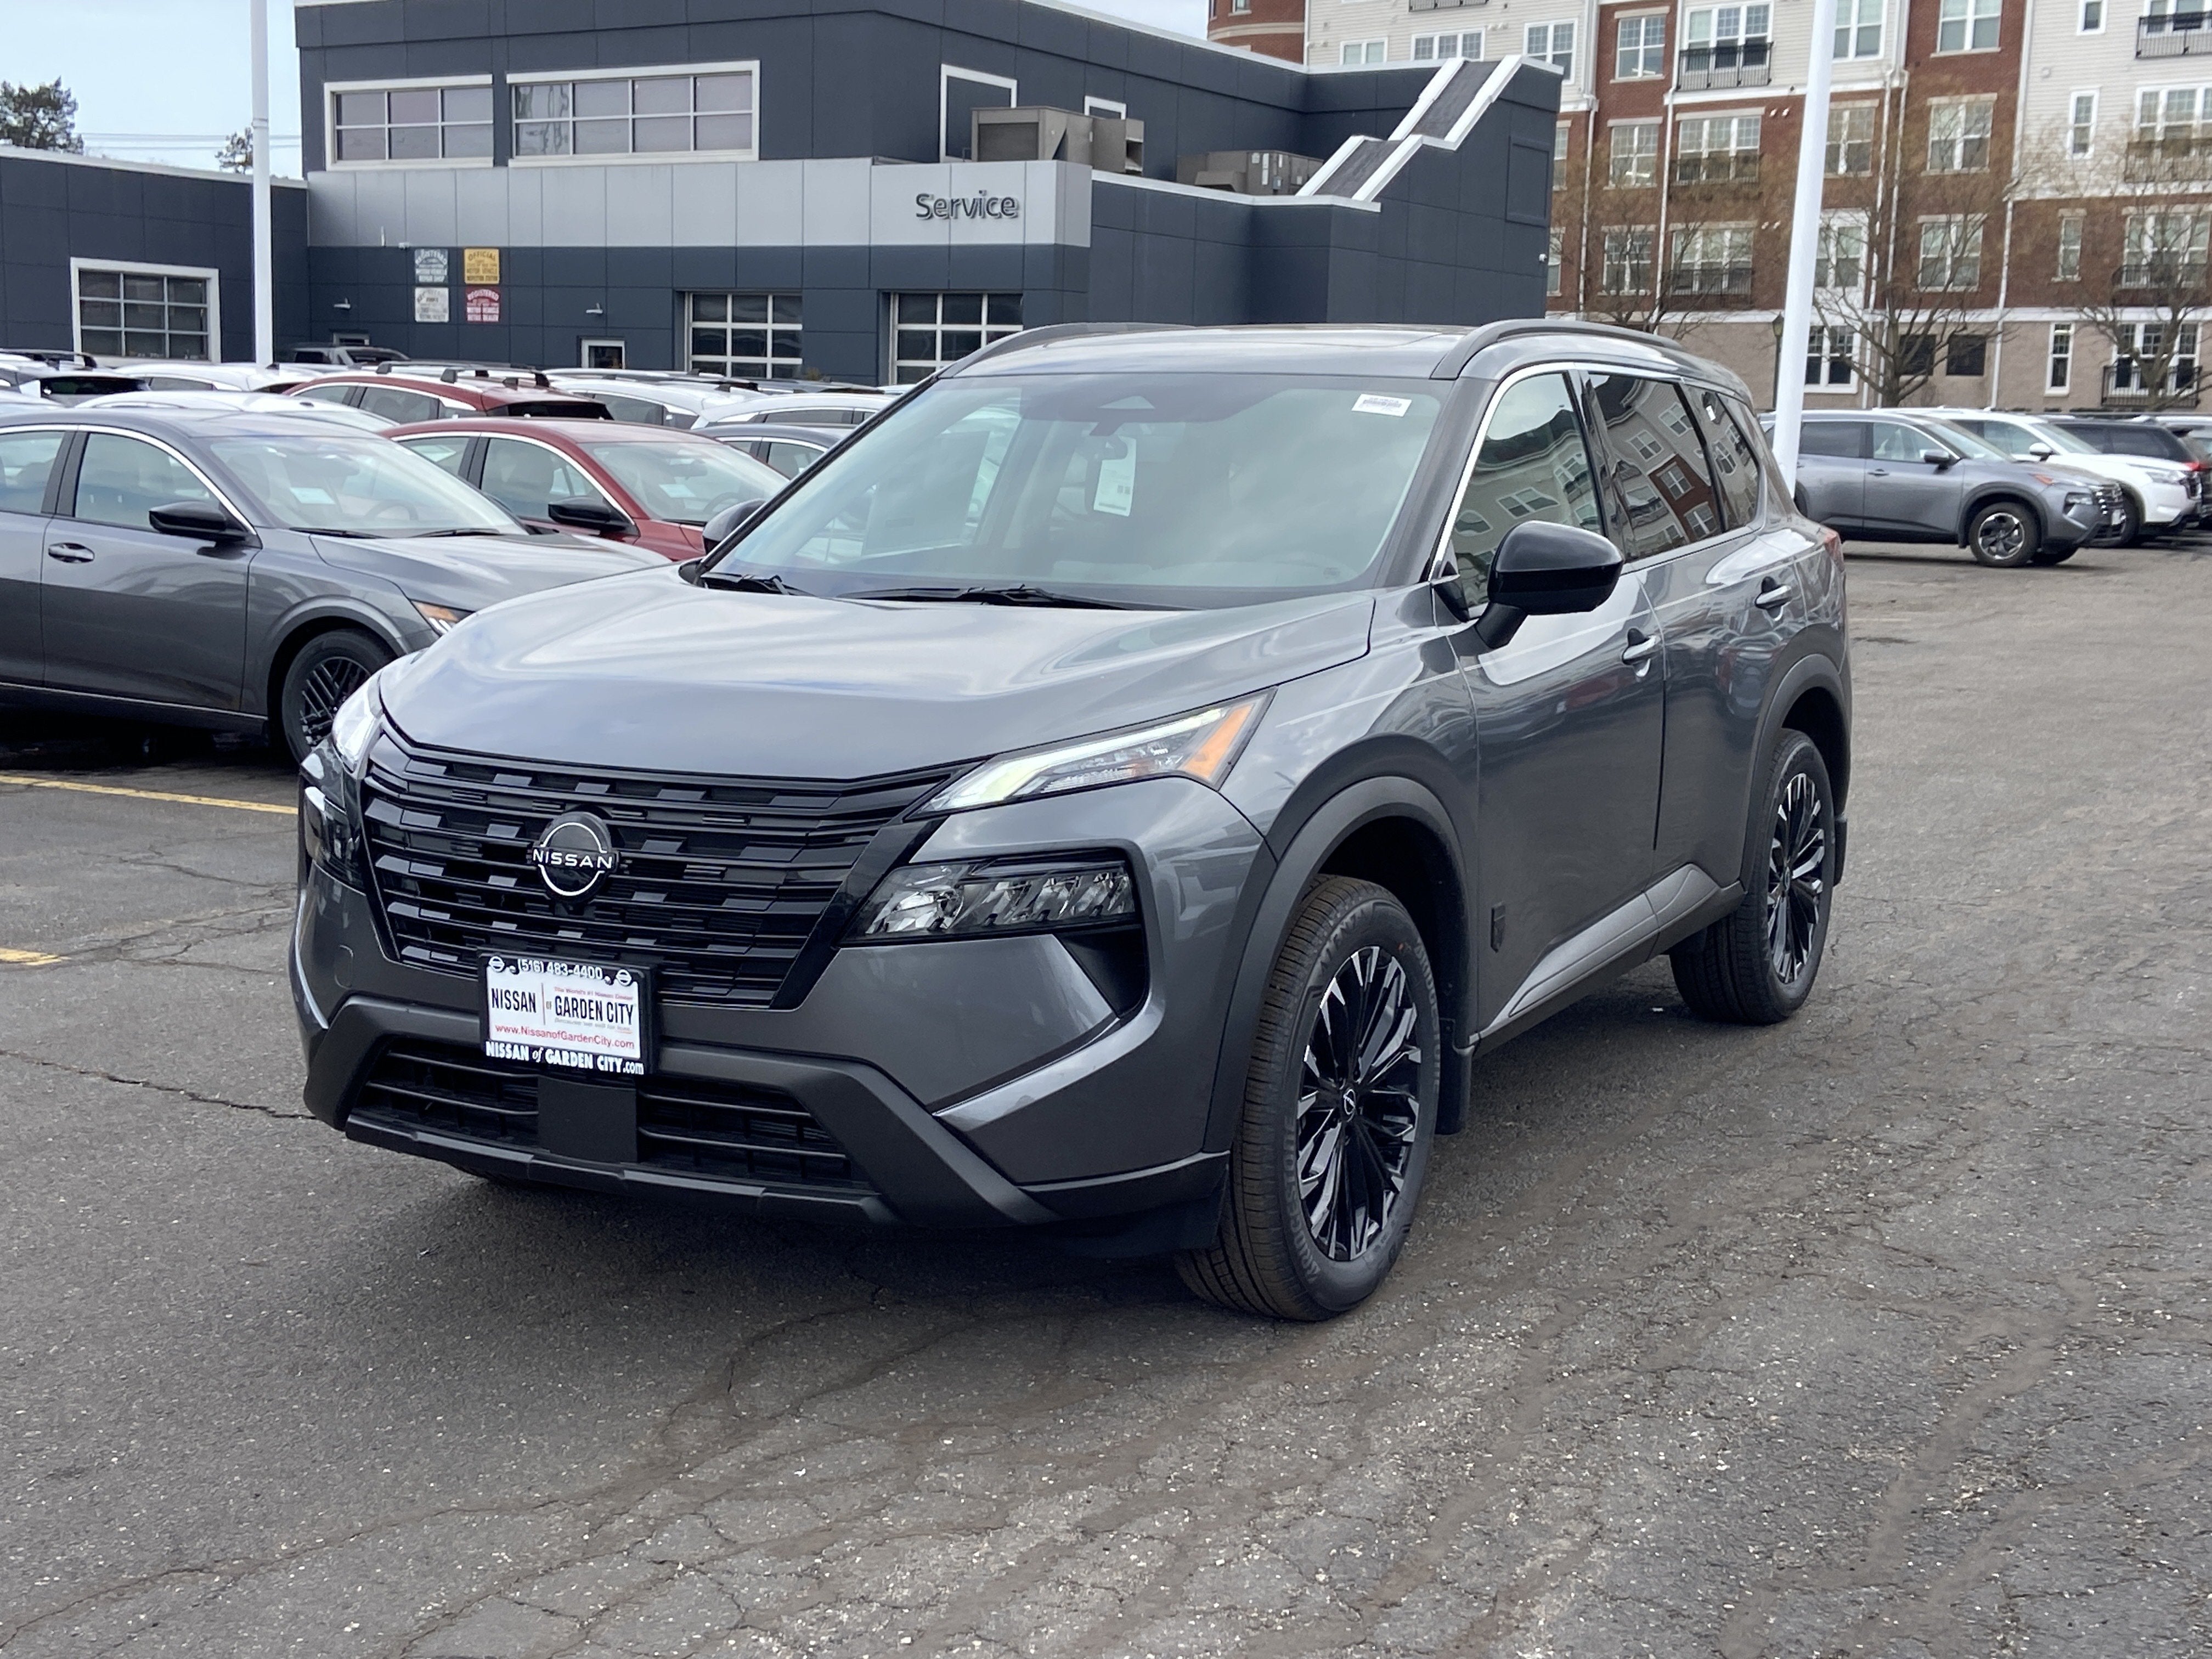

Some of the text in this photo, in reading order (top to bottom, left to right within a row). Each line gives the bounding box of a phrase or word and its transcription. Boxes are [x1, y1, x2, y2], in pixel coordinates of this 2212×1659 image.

[916, 190, 1019, 220] Service
[468, 251, 496, 261] OFFICIAL
[533, 849, 612, 868] NISSAN
[547, 961, 603, 980] 483-4400
[491, 988, 536, 1013] NISSAN
[555, 996, 603, 1022] GARDEN
[607, 1002, 634, 1025] CITY
[495, 1024, 634, 1049] www.NissanofGardenCity.com
[486, 1041, 529, 1062] NISSAN
[532, 1047, 543, 1062] of
[545, 1048, 593, 1069] GARDEN
